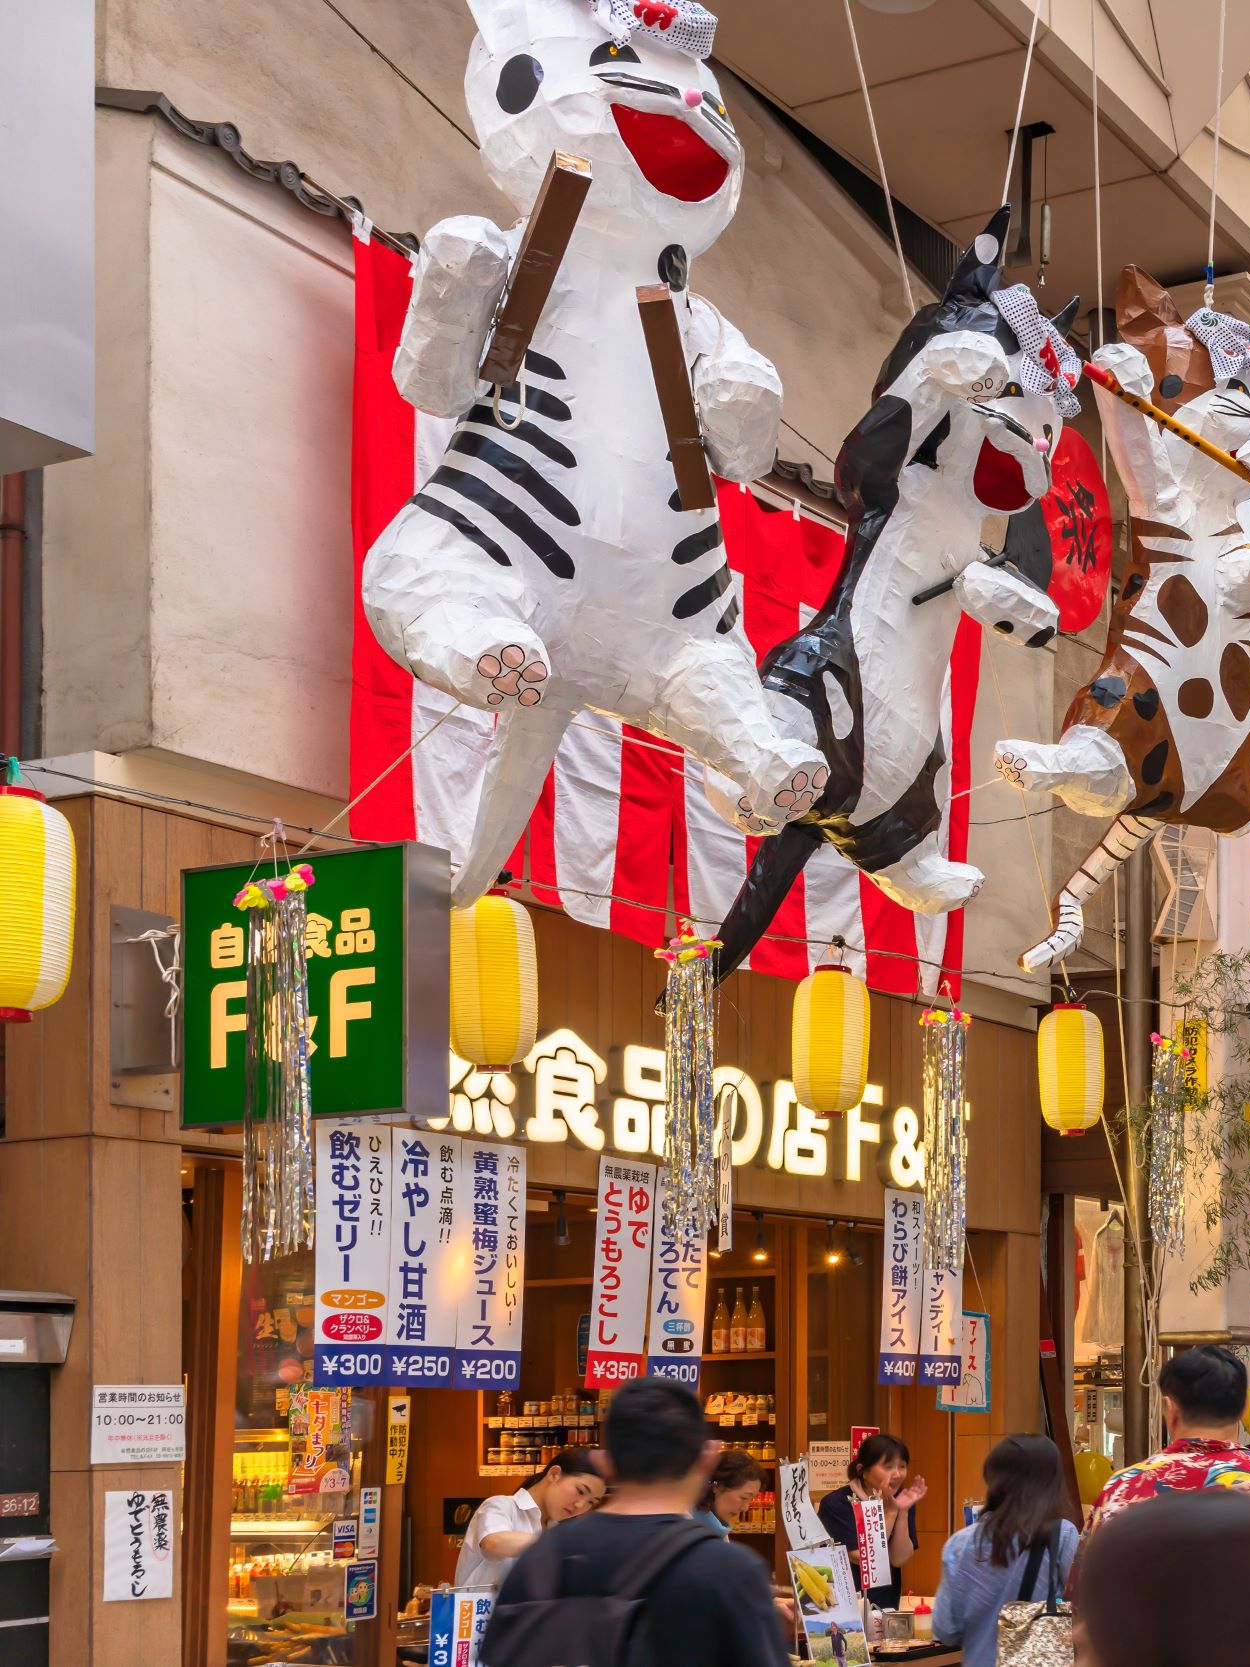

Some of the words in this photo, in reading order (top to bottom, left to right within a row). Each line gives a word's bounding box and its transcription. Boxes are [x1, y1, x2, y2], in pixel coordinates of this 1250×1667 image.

[211, 908, 375, 969] 自食品
[604, 1164, 650, 1184] 無農薬栽培
[329, 1130, 362, 1282] 飲むゼリー
[628, 1186, 650, 1249] ゆで
[397, 1139, 430, 1341] 冷やし甘酒
[470, 1151, 499, 1346] 黄熟蜜梅ジュース
[505, 1156, 520, 1326] 冷たくておいしい!
[598, 1182, 624, 1345] とうもろこし
[890, 1198, 908, 1347] わらび餅アイス
[331, 1293, 378, 1306] マンゴー
[330, 1324, 377, 1334] クランベリー
[340, 1315, 369, 1324] ザクロ&
[967, 1320, 977, 1371] アイス
[322, 1354, 381, 1375] ¥300
[392, 1356, 450, 1377] ¥250
[461, 1359, 516, 1380] ¥200
[593, 1360, 638, 1380] ¥350
[654, 1365, 698, 1382] ¥300
[884, 1361, 915, 1376] ¥400
[924, 1362, 959, 1378] ¥270
[98, 1392, 181, 1403] 営業時間のお知らせ
[305, 1400, 328, 1469] 七夕まつり
[389, 1425, 398, 1459] 作動中
[397, 1425, 407, 1482] 防犯カメラ
[151, 1494, 170, 1551] 無農薬
[337, 1524, 355, 1534] VISA
[871, 1505, 880, 1532] ゆで
[865, 1506, 878, 1584] とうもろこし
[461, 1602, 471, 1637] マンゴー
